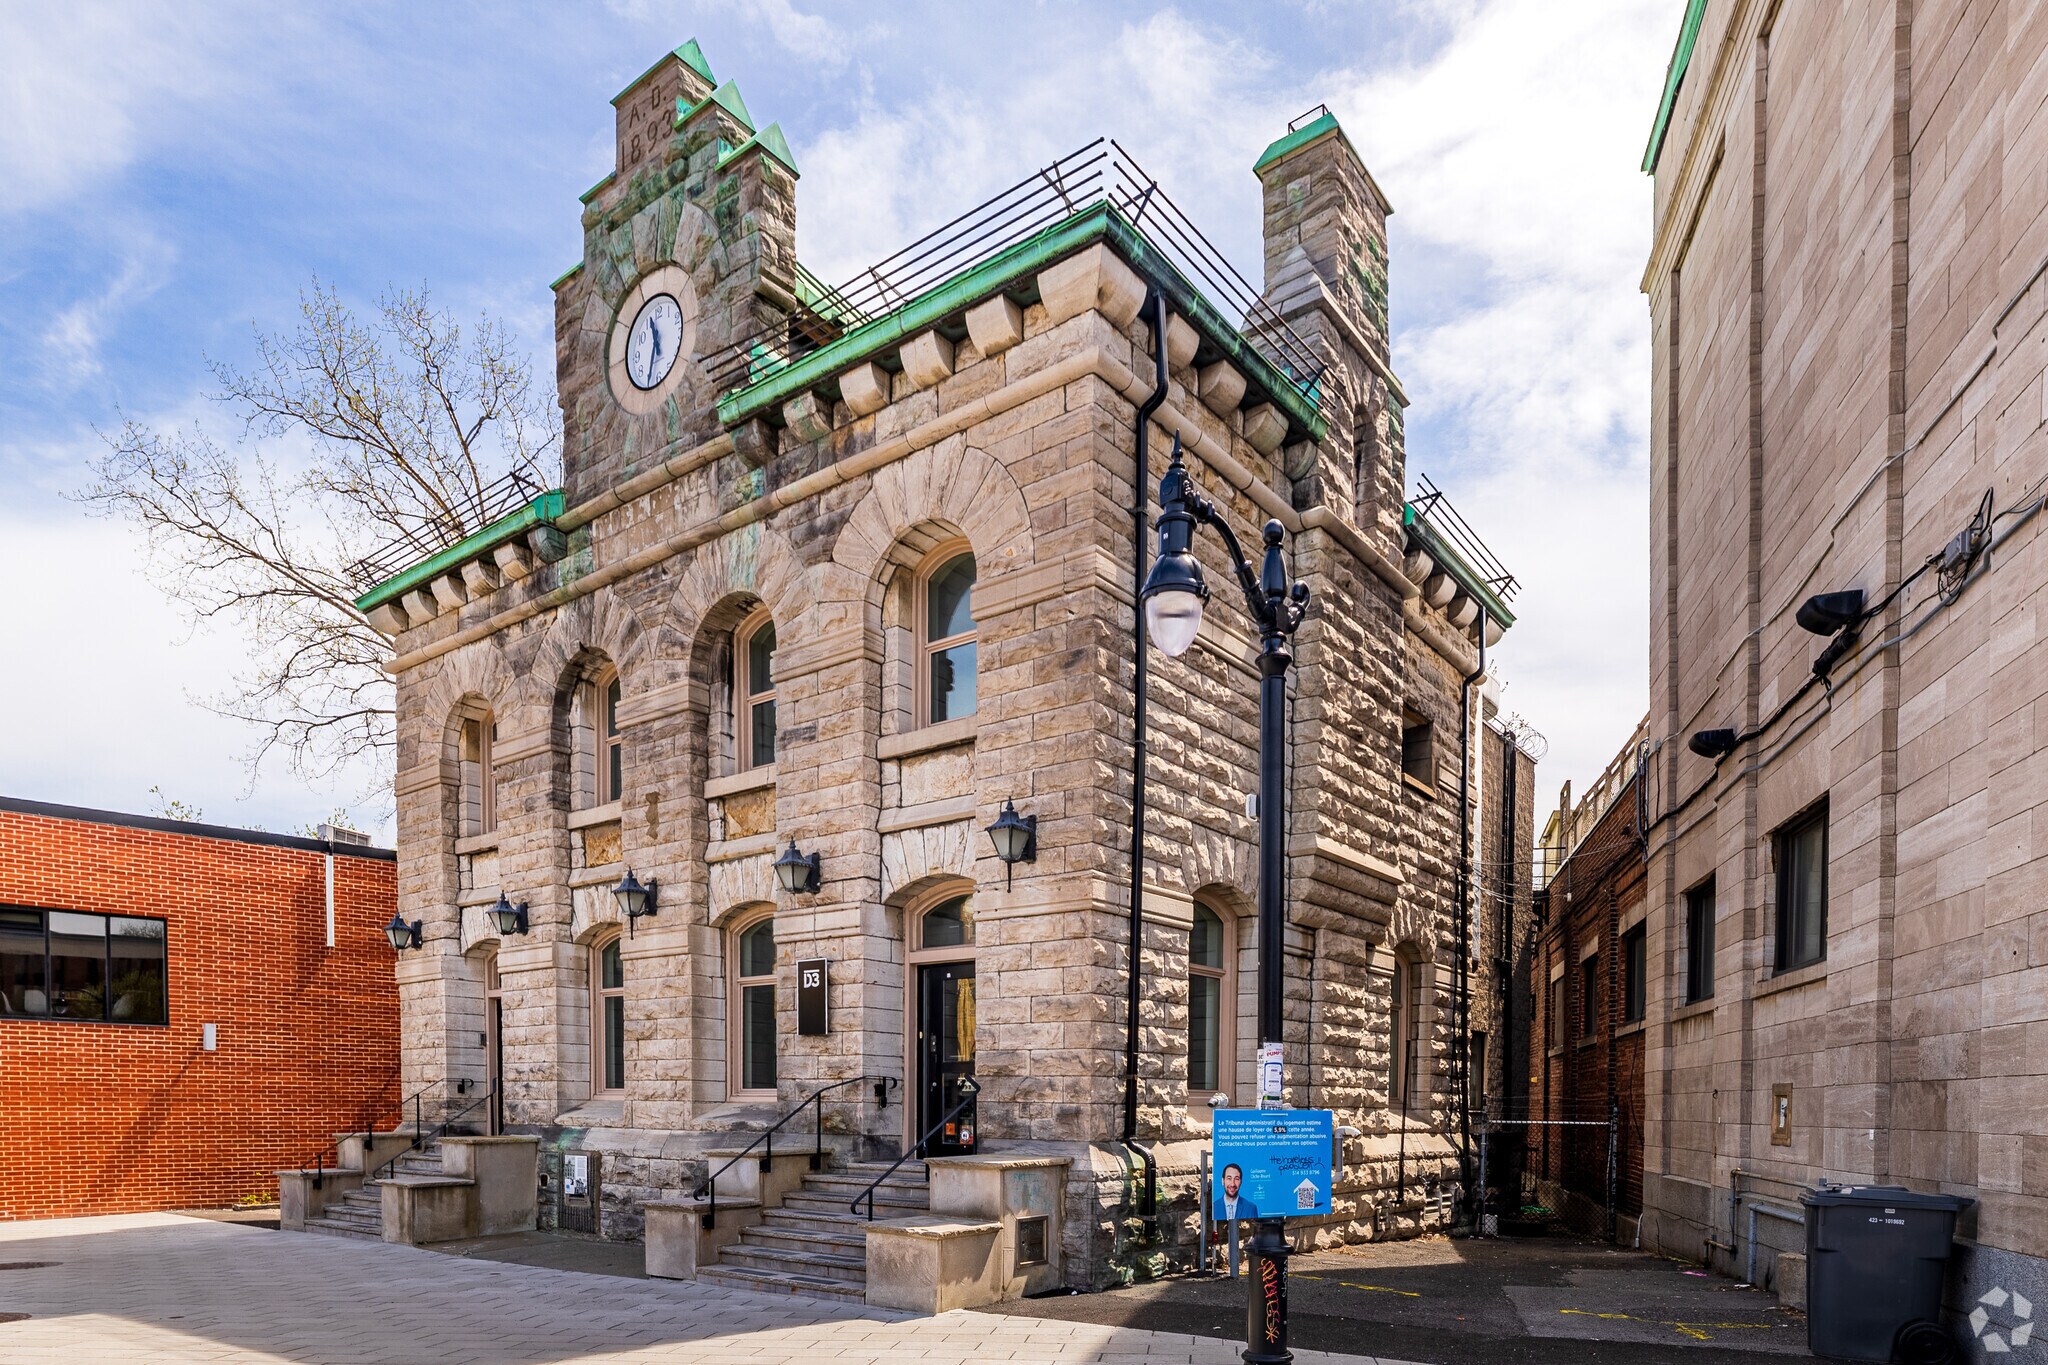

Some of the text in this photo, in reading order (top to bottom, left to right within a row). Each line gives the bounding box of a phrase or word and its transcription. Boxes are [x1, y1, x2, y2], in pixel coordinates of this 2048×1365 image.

[621, 109, 674, 174] 1893
[655, 305, 663, 322] 12
[638, 331, 647, 346] 10
[634, 350, 641, 364] 9
[638, 364, 644, 378] 8
[803, 971, 820, 988] D3
